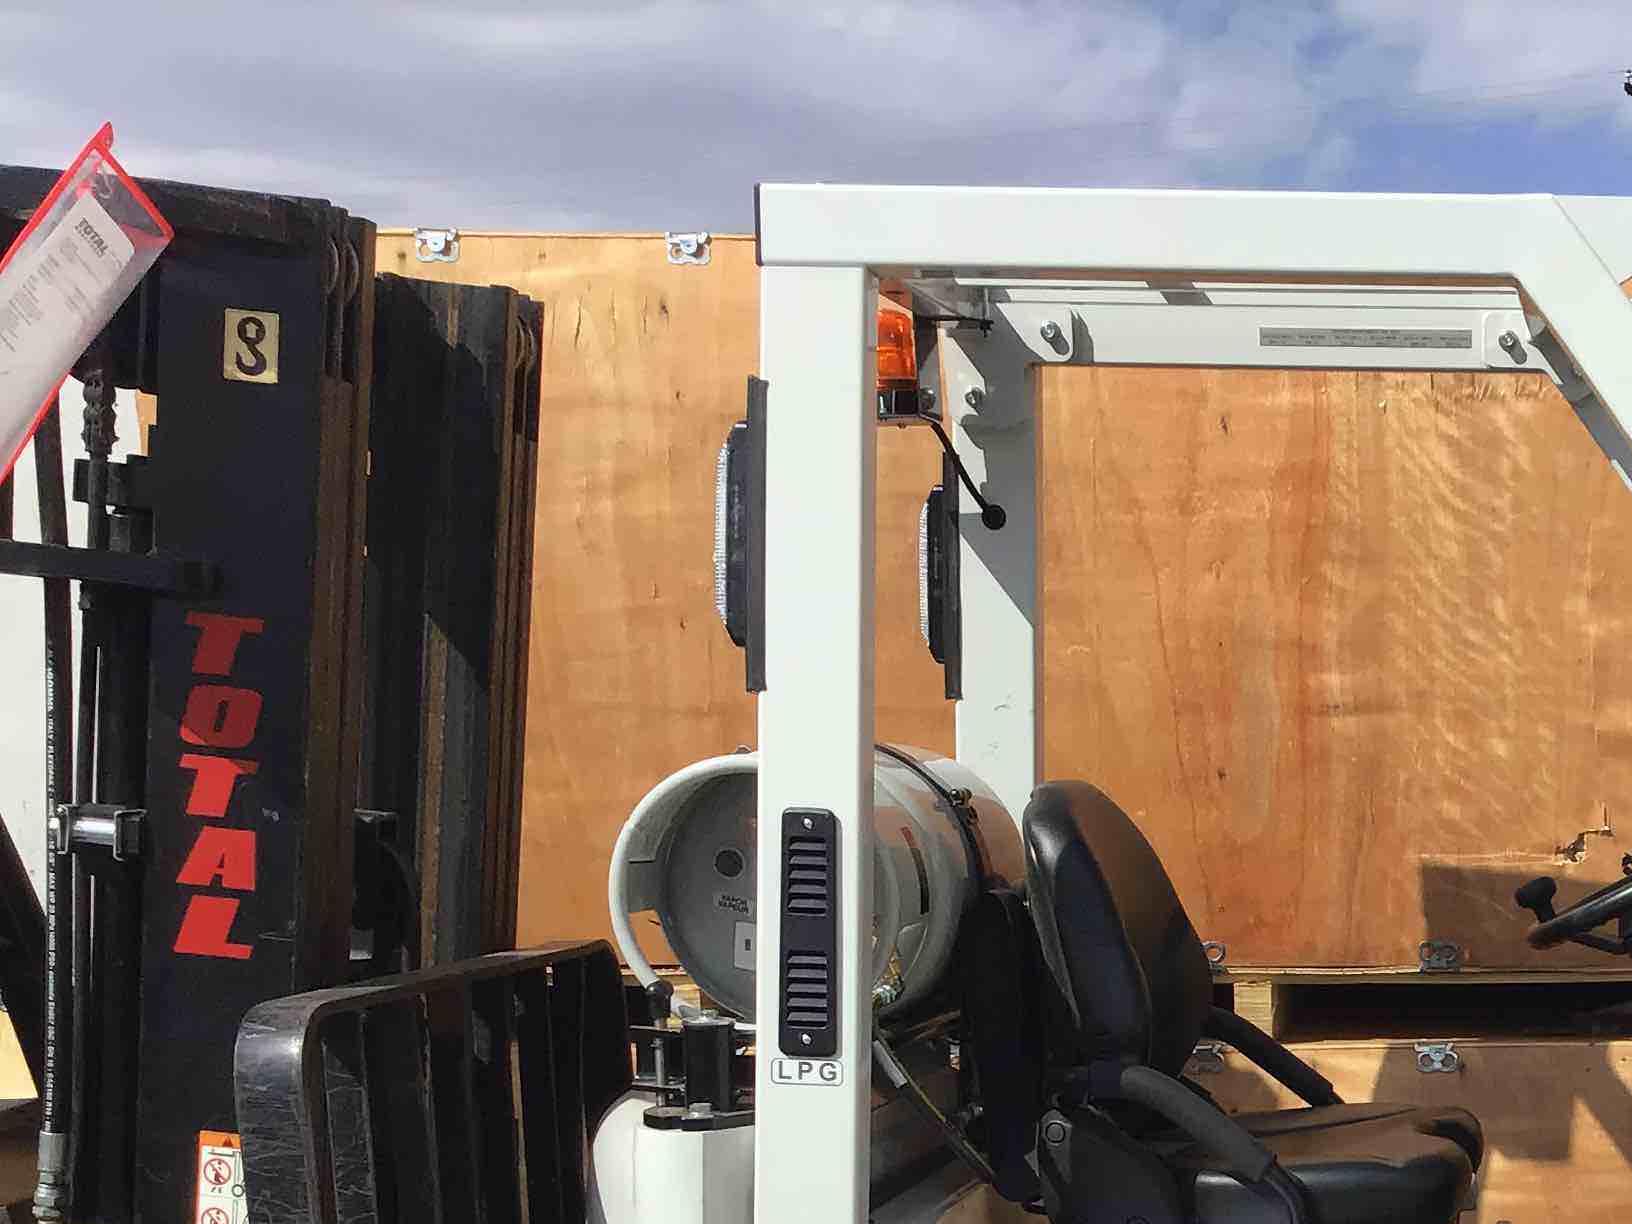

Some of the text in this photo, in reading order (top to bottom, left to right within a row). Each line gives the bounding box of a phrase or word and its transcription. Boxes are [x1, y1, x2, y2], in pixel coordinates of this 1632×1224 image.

[79, 217, 109, 255] TOTAL
[173, 612, 265, 959] TOTAL
[777, 1061, 838, 1082] LPG
